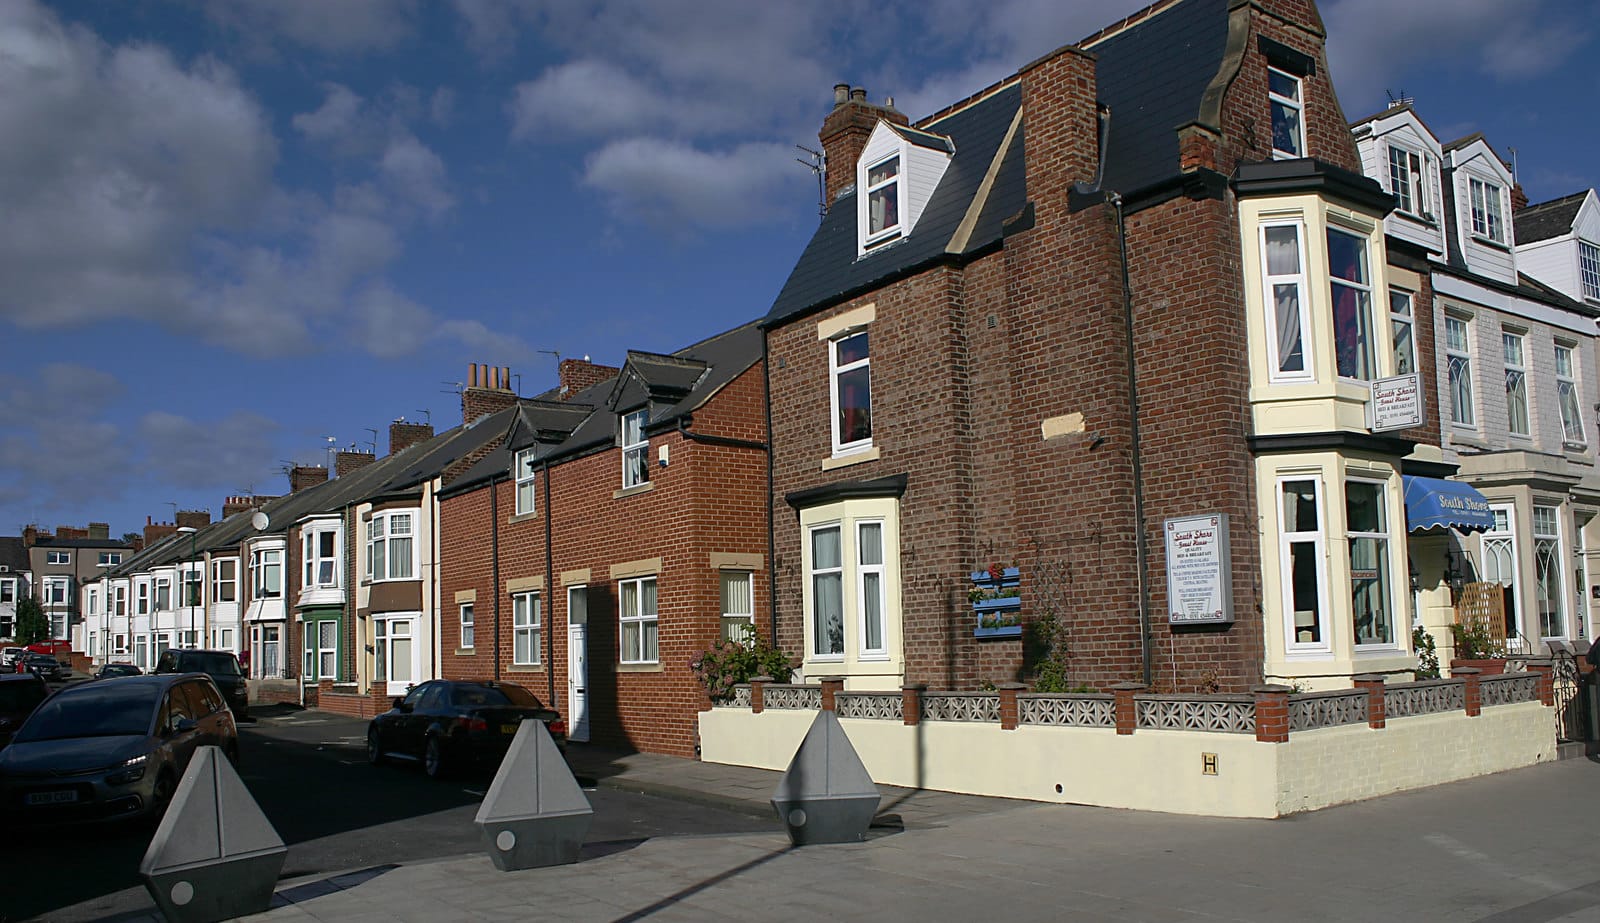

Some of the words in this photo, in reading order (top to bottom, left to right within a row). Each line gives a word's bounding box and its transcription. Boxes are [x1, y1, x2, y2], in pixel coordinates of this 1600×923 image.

[1376, 390, 1395, 399] South
[1397, 387, 1416, 396] Shore
[1439, 494, 1464, 509] South
[1465, 497, 1489, 511] Shore
[1174, 532, 1193, 541] South
[1194, 530, 1212, 539] Shore
[1204, 755, 1216, 773] H
